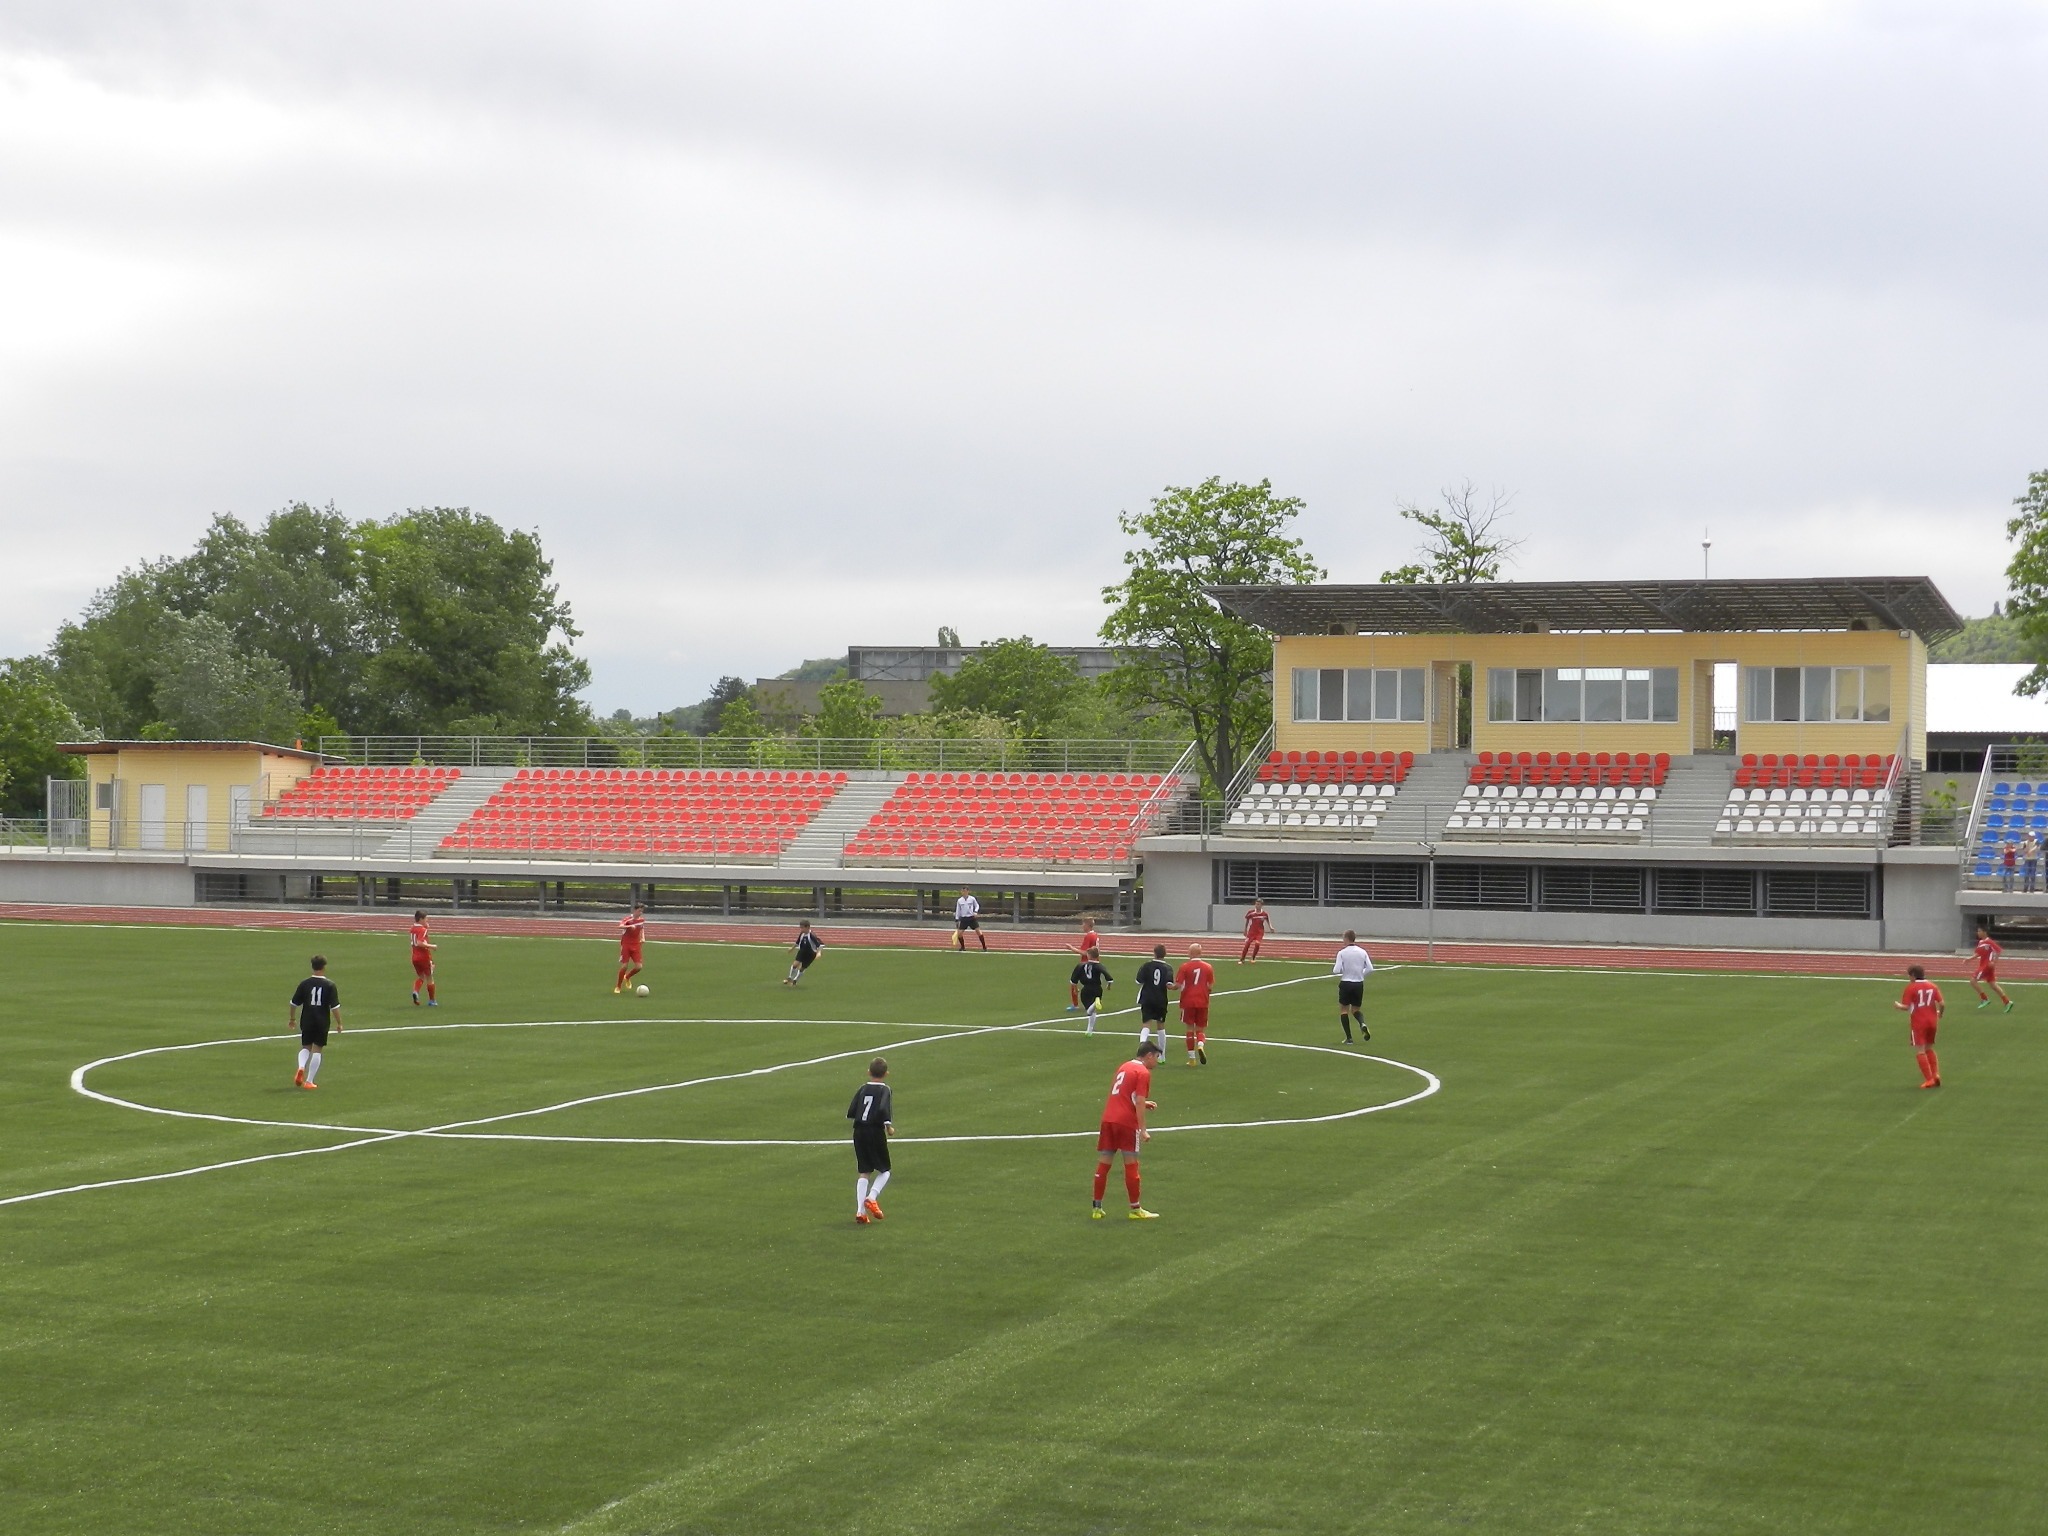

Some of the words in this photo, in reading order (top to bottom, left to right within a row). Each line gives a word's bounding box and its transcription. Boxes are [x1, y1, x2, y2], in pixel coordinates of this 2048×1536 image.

[1153, 968, 1161, 986] 9
[1193, 967, 1201, 985] 7
[310, 986, 323, 1006] 11
[1917, 988, 1934, 1007] 17
[1111, 1071, 1125, 1095] 2
[861, 1095, 874, 1121] 7
